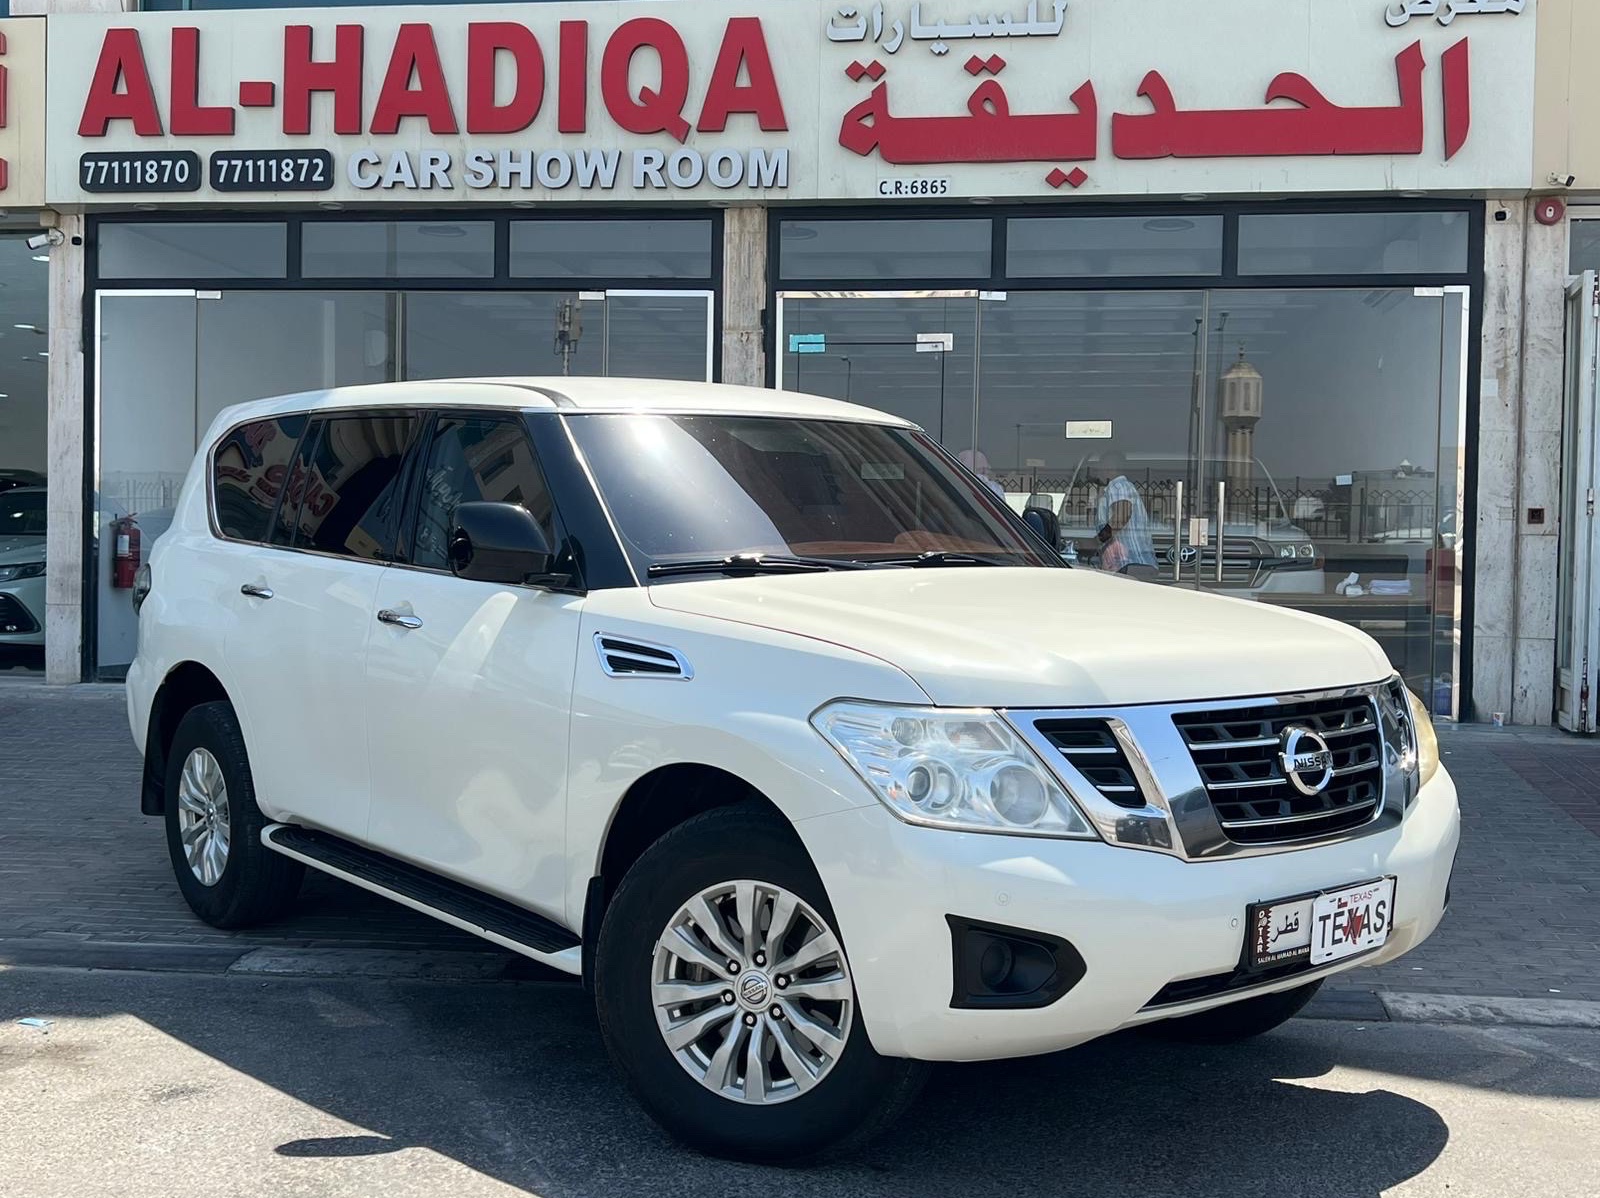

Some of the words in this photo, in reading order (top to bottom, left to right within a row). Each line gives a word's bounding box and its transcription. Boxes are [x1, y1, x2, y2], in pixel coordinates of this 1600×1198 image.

[826, 0, 1067, 55] للسيارات
[78, 17, 789, 142] AL-HADIQA
[838, 37, 1470, 189] الحديقة
[84, 159, 190, 184] 77111870
[216, 158, 324, 183] 77111872
[349, 150, 453, 190] CAR
[463, 149, 622, 189] SHOW
[633, 148, 789, 189] ROOM
[879, 180, 947, 195] C.R:6865
[1350, 890, 1373, 904] TEXAS
[1270, 911, 1300, 943] قطر
[1319, 900, 1386, 949] TEXAS
